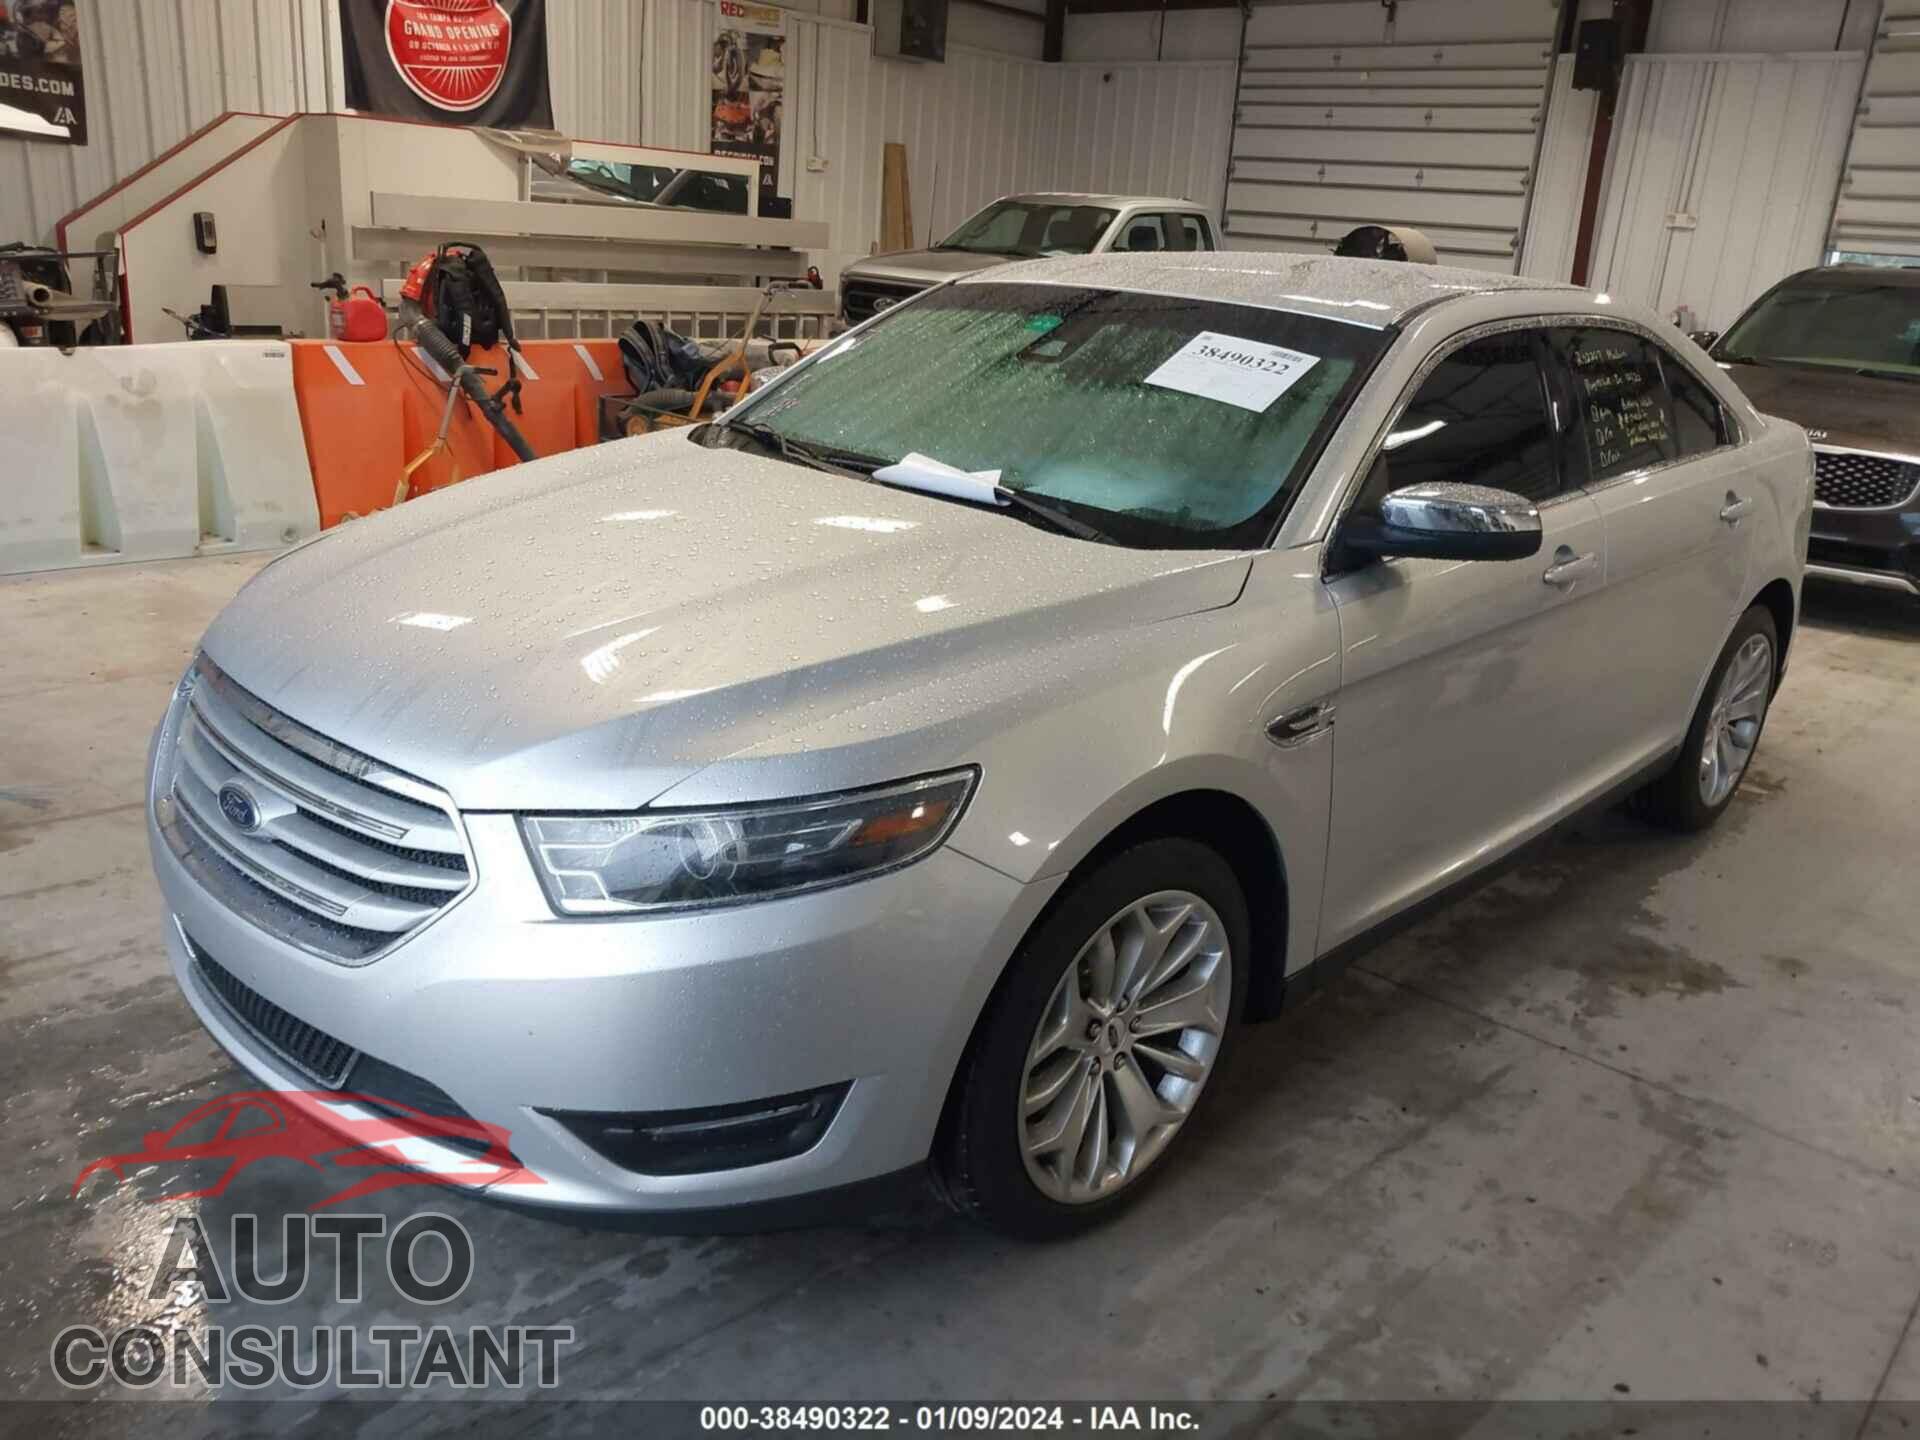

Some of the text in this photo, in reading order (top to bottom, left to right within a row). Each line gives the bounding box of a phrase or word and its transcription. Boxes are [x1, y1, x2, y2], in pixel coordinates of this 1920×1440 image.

[404, 20, 500, 40] GRAND OPENING
[1192, 345, 1290, 376] 38490322
